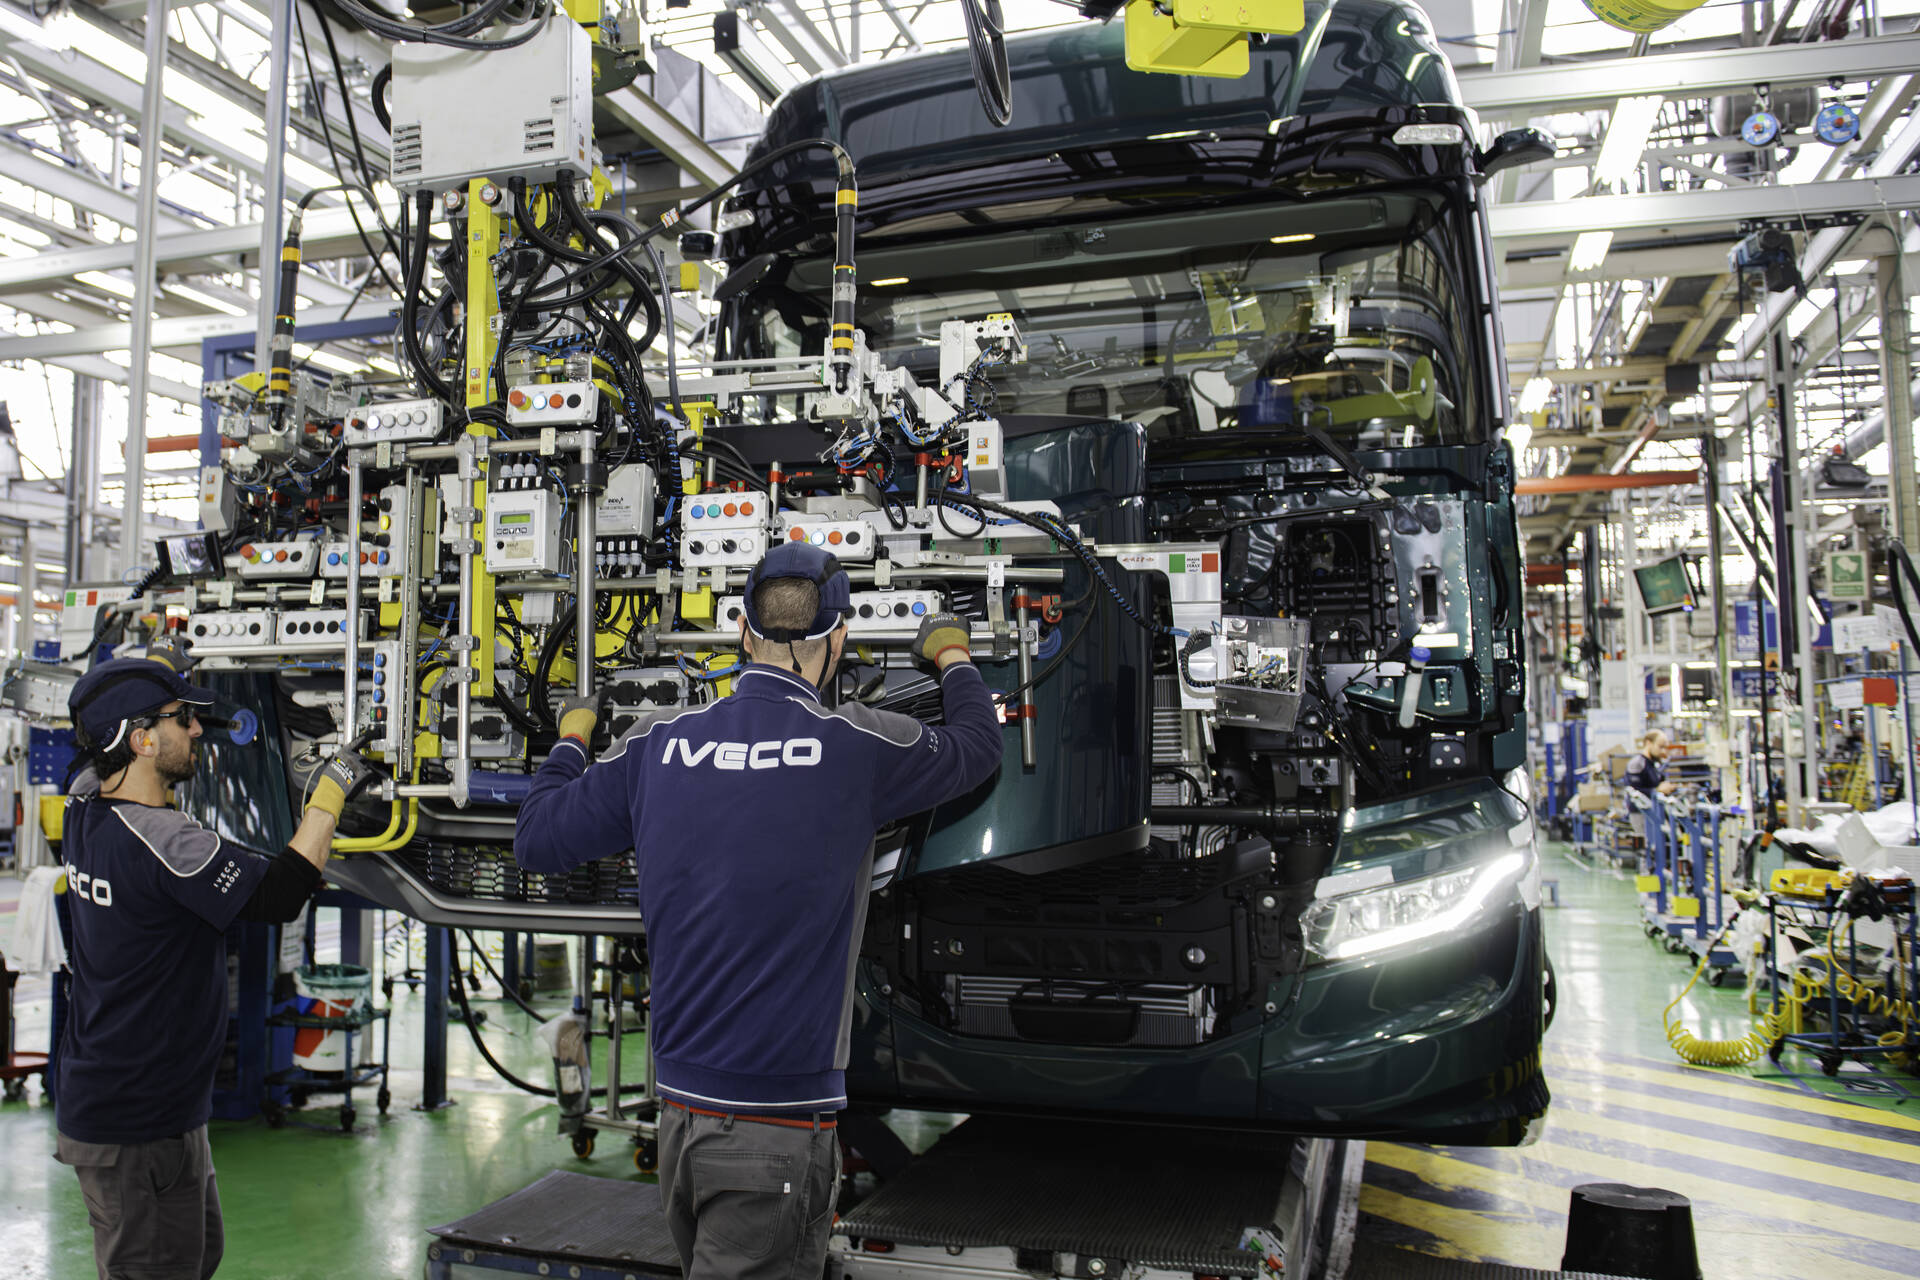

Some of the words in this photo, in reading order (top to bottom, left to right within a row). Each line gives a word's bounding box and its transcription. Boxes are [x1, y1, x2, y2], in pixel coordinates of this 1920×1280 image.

[662, 737, 822, 770] IVECO
[64, 858, 112, 907] ECO
[213, 860, 235, 888] IVECO
